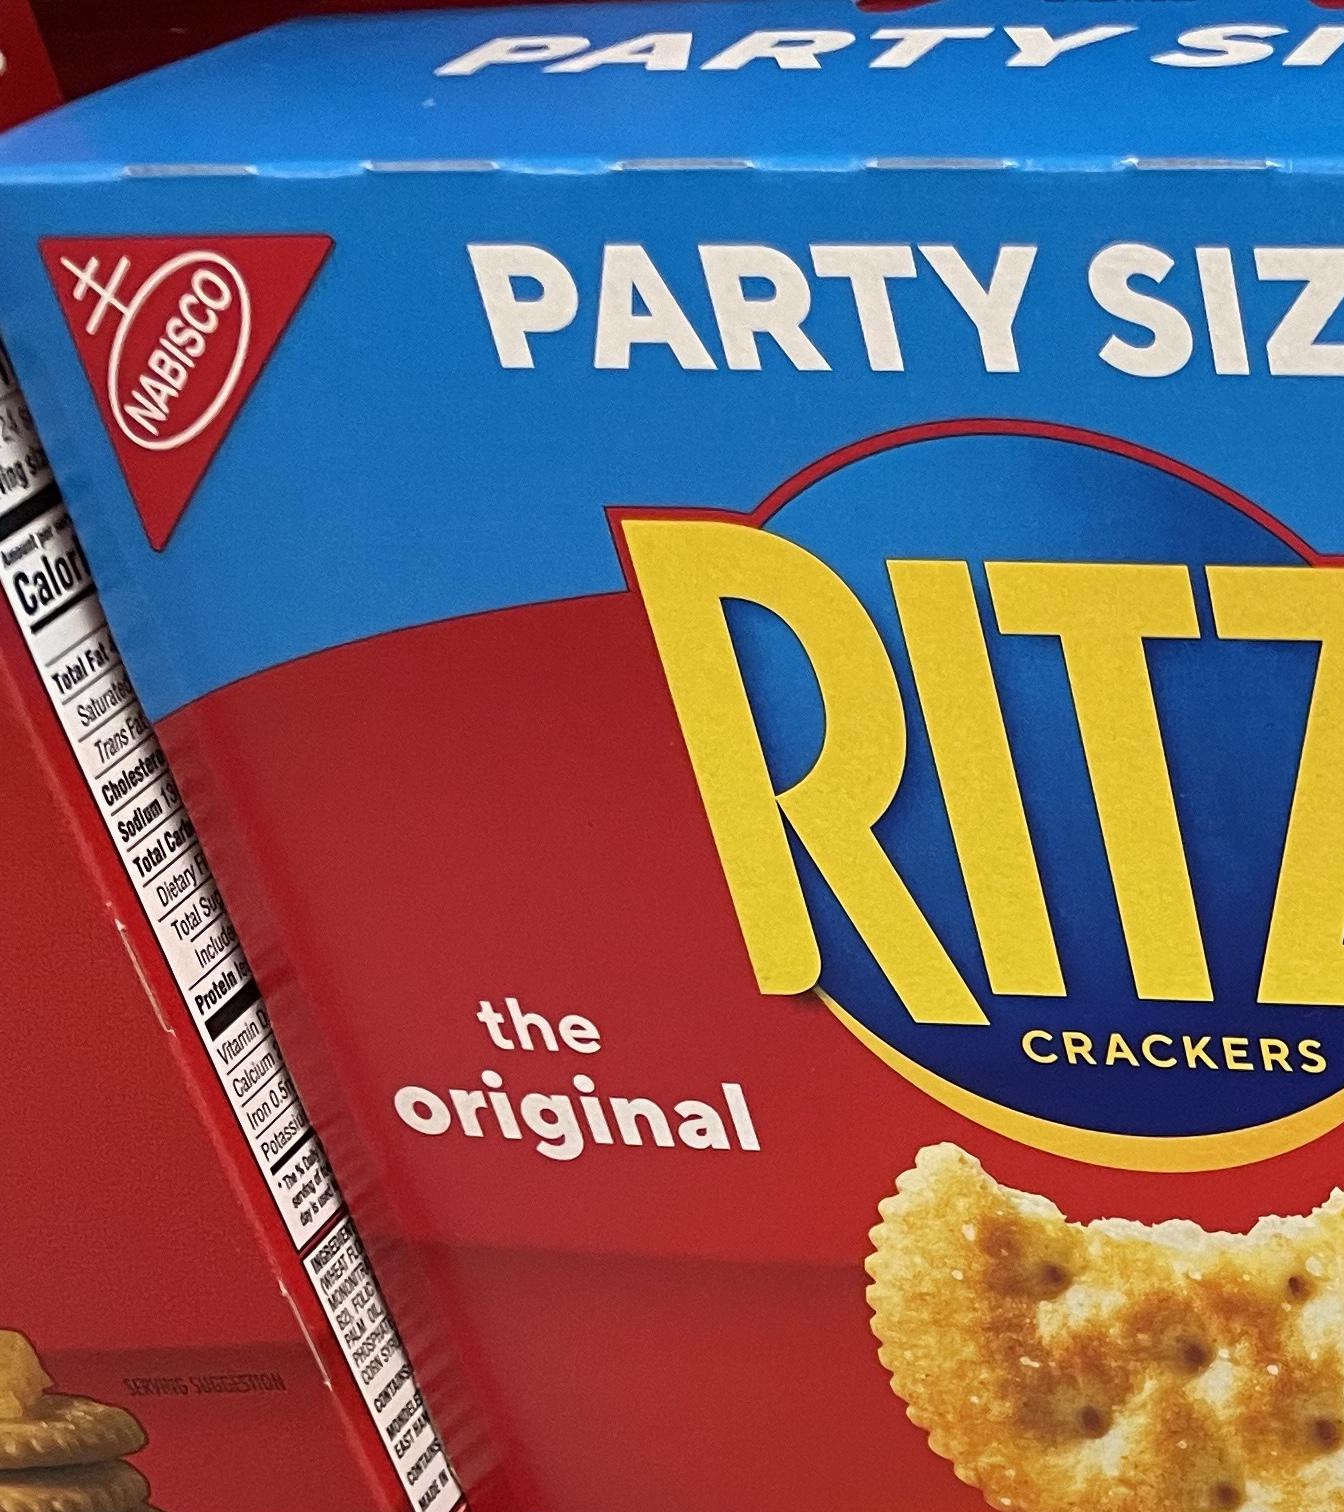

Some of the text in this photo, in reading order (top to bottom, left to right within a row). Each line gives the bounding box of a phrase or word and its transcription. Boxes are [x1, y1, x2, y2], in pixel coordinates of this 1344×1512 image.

[434, 26, 1136, 76] PARTY
[468, 243, 1038, 375] PARTY
[125, 269, 232, 436] NABISCO
[477, 997, 601, 1055] the
[1021, 1031, 1327, 1074] CRACKERS
[394, 1070, 761, 1161] original
